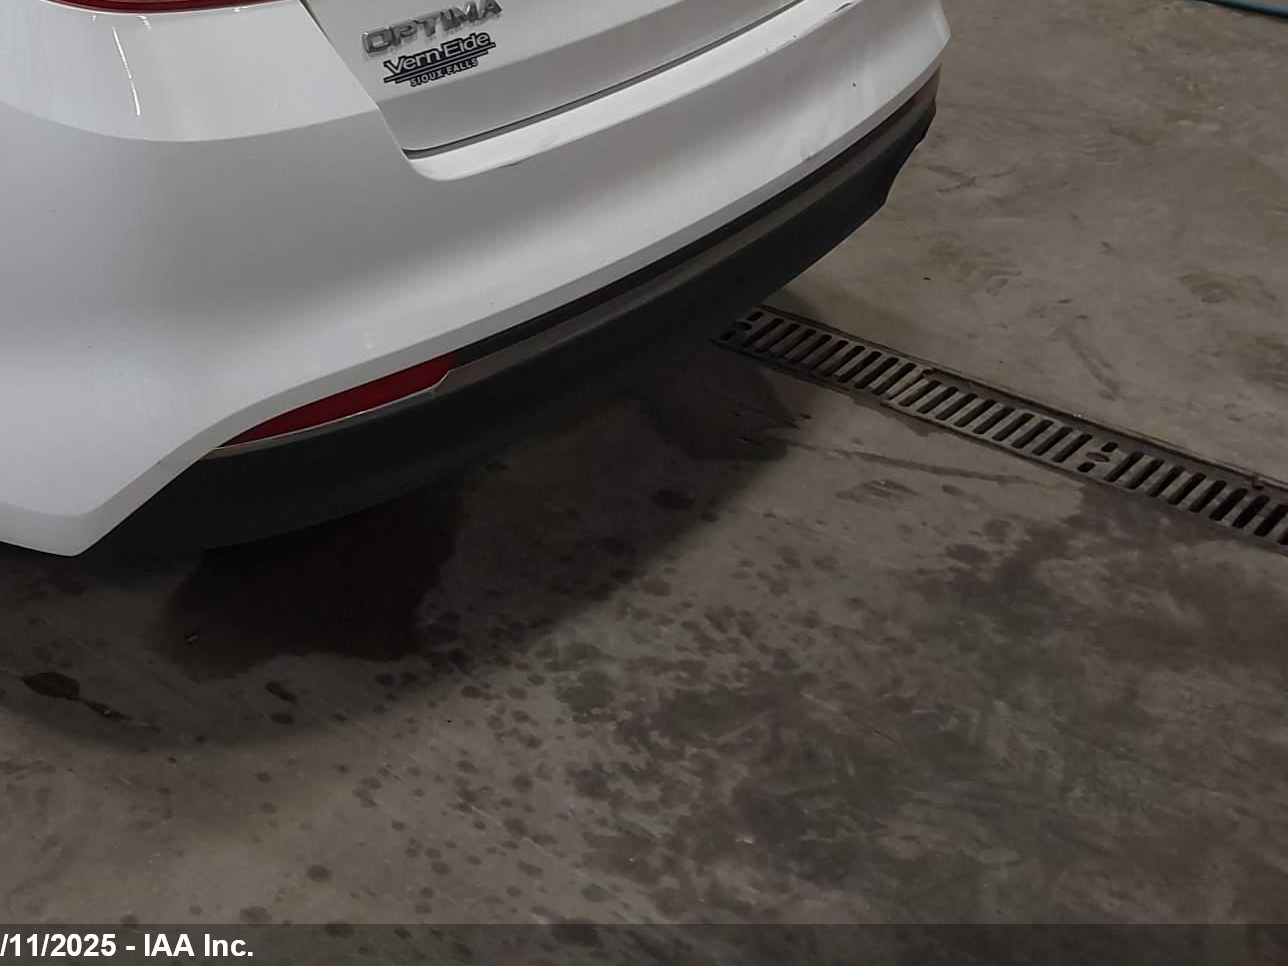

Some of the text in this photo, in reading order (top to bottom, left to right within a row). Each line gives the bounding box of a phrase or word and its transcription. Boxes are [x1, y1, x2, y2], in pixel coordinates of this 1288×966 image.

[384, 32, 491, 75] Vern Eide
[410, 57, 479, 87] SIOUX FALLS
